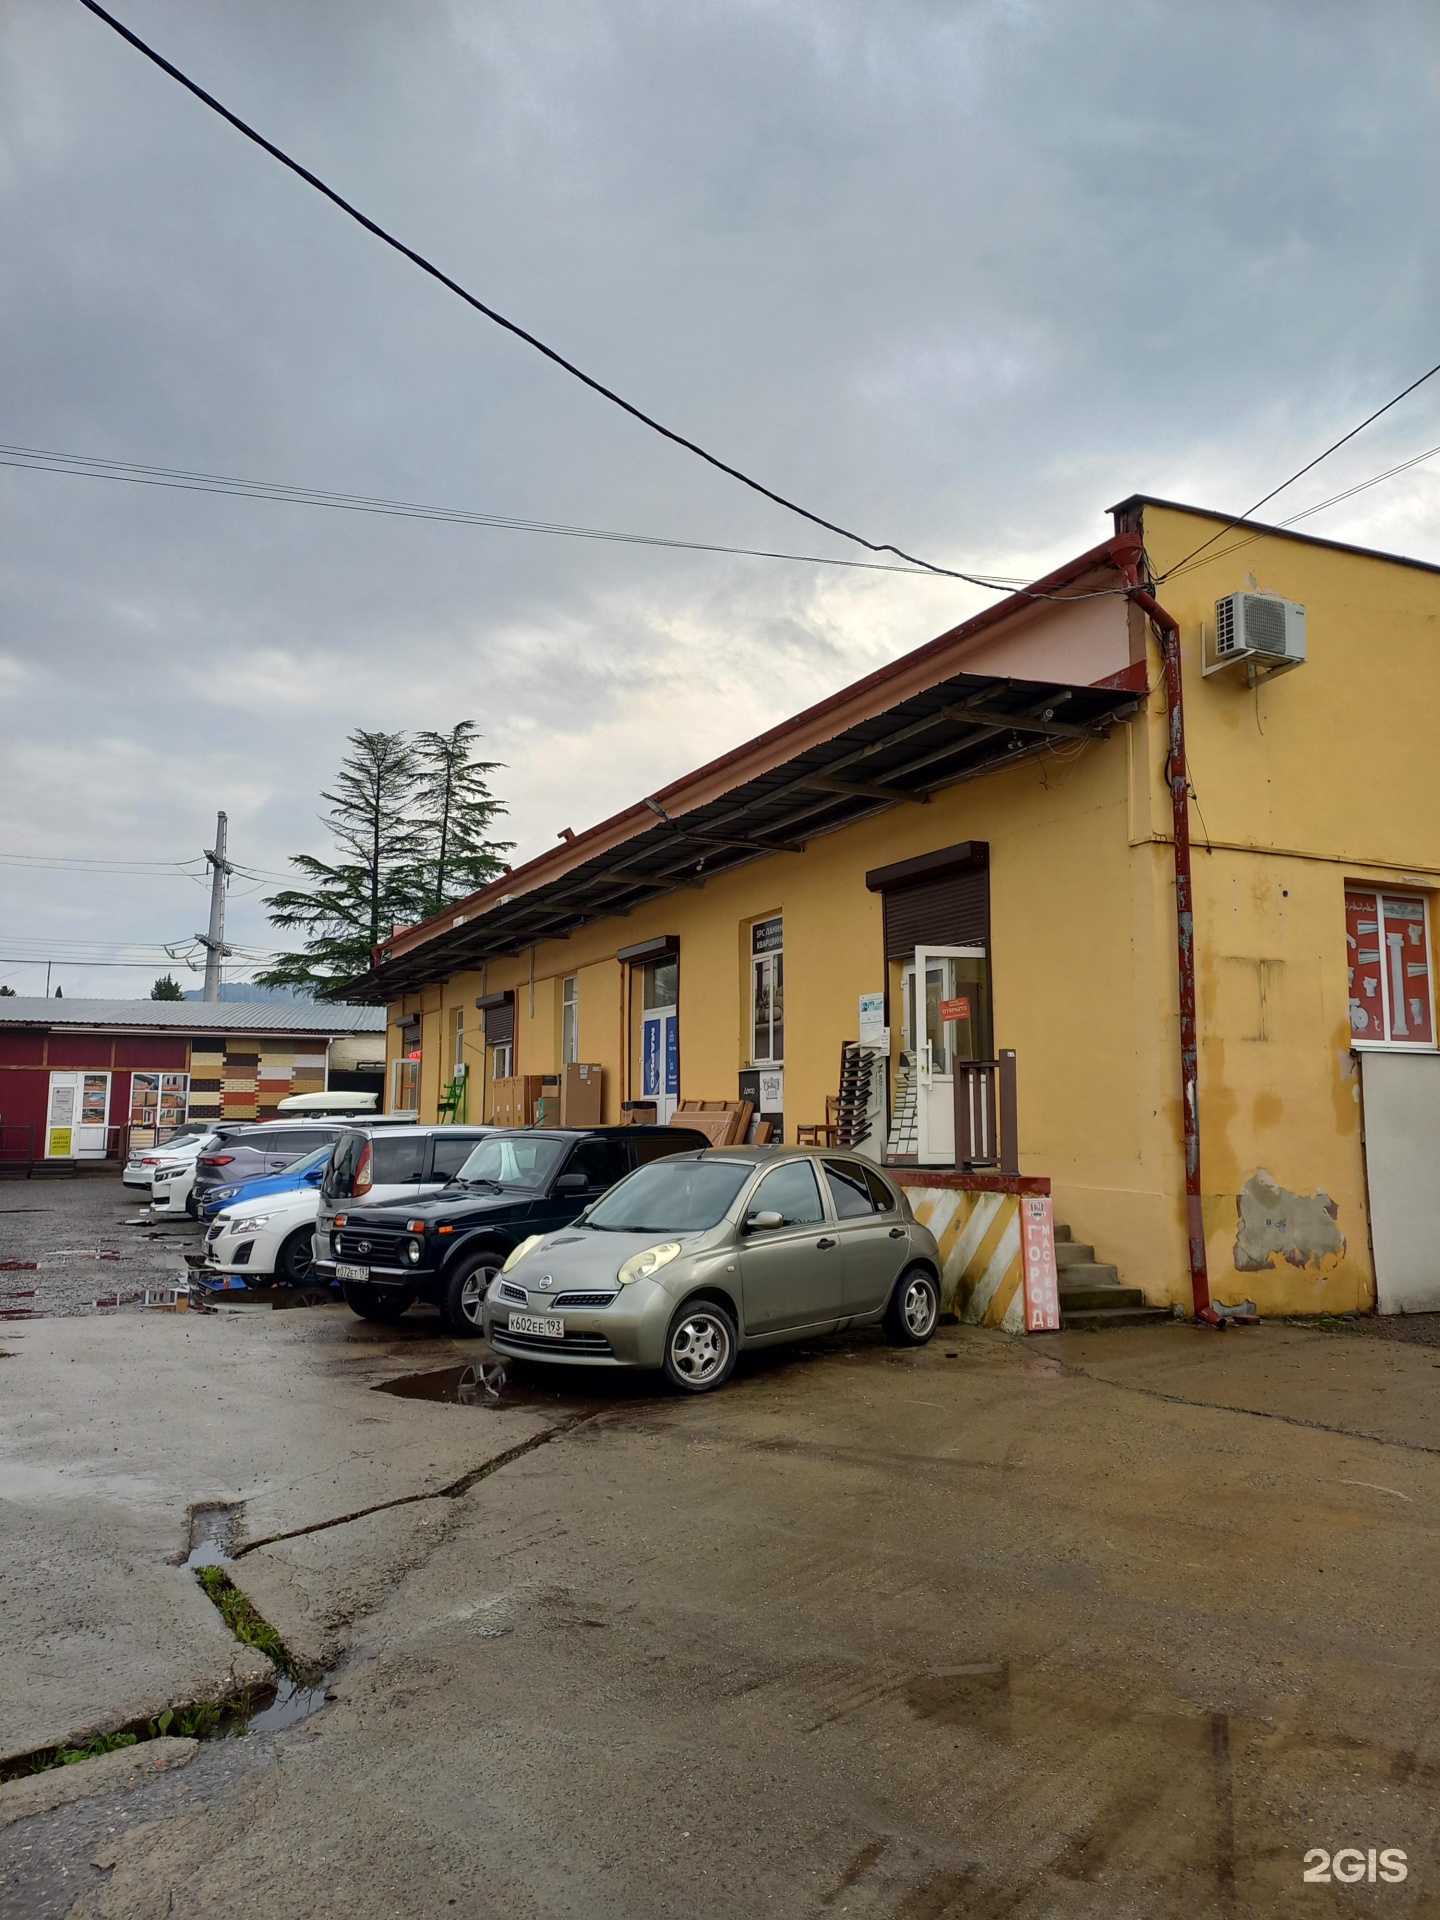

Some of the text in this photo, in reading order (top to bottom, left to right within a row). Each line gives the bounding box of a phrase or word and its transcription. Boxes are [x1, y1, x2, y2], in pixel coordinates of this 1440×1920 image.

[1028, 1225, 1044, 1329] ГОРОД
[510, 1316, 561, 1334] К602ЕЕ 193
